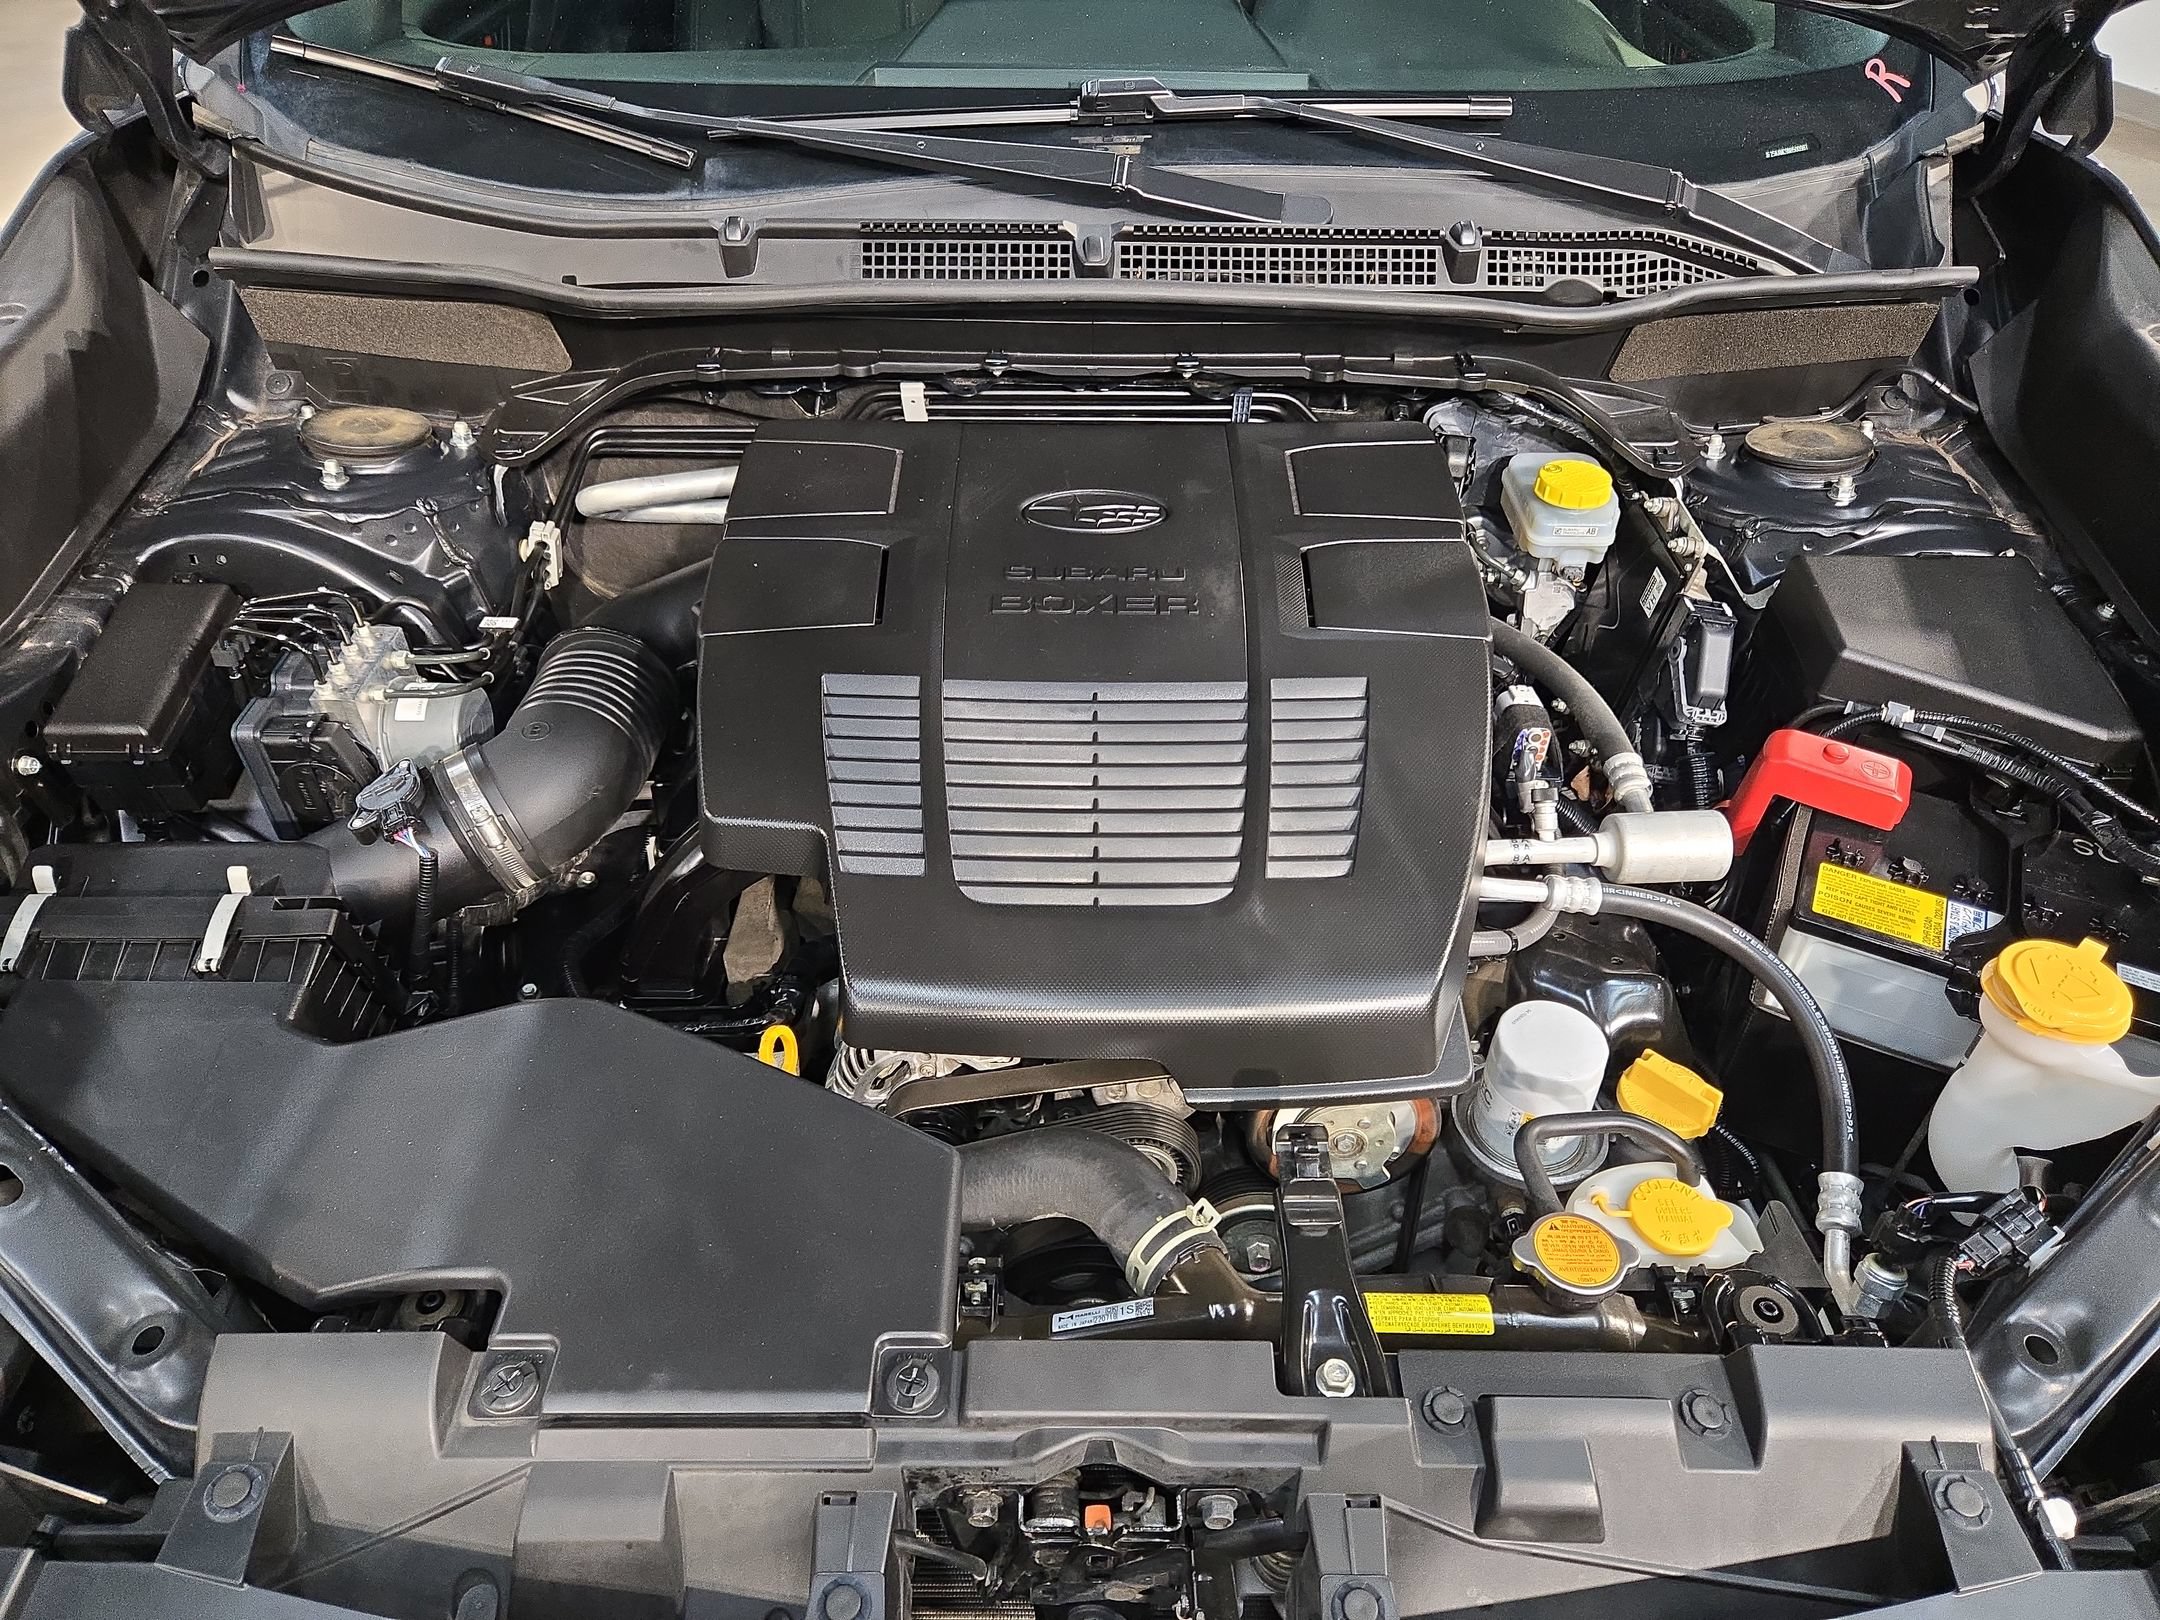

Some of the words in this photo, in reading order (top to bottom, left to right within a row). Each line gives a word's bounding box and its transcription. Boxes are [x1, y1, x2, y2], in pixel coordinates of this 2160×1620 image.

[1865, 58, 1911, 103] R
[1004, 565, 1187, 582] SUBARU
[990, 594, 1200, 616] BOXER
[1822, 865, 1857, 880] DANGER
[1818, 890, 1853, 905] POISON
[1633, 1180, 1704, 1201] COOLANT
